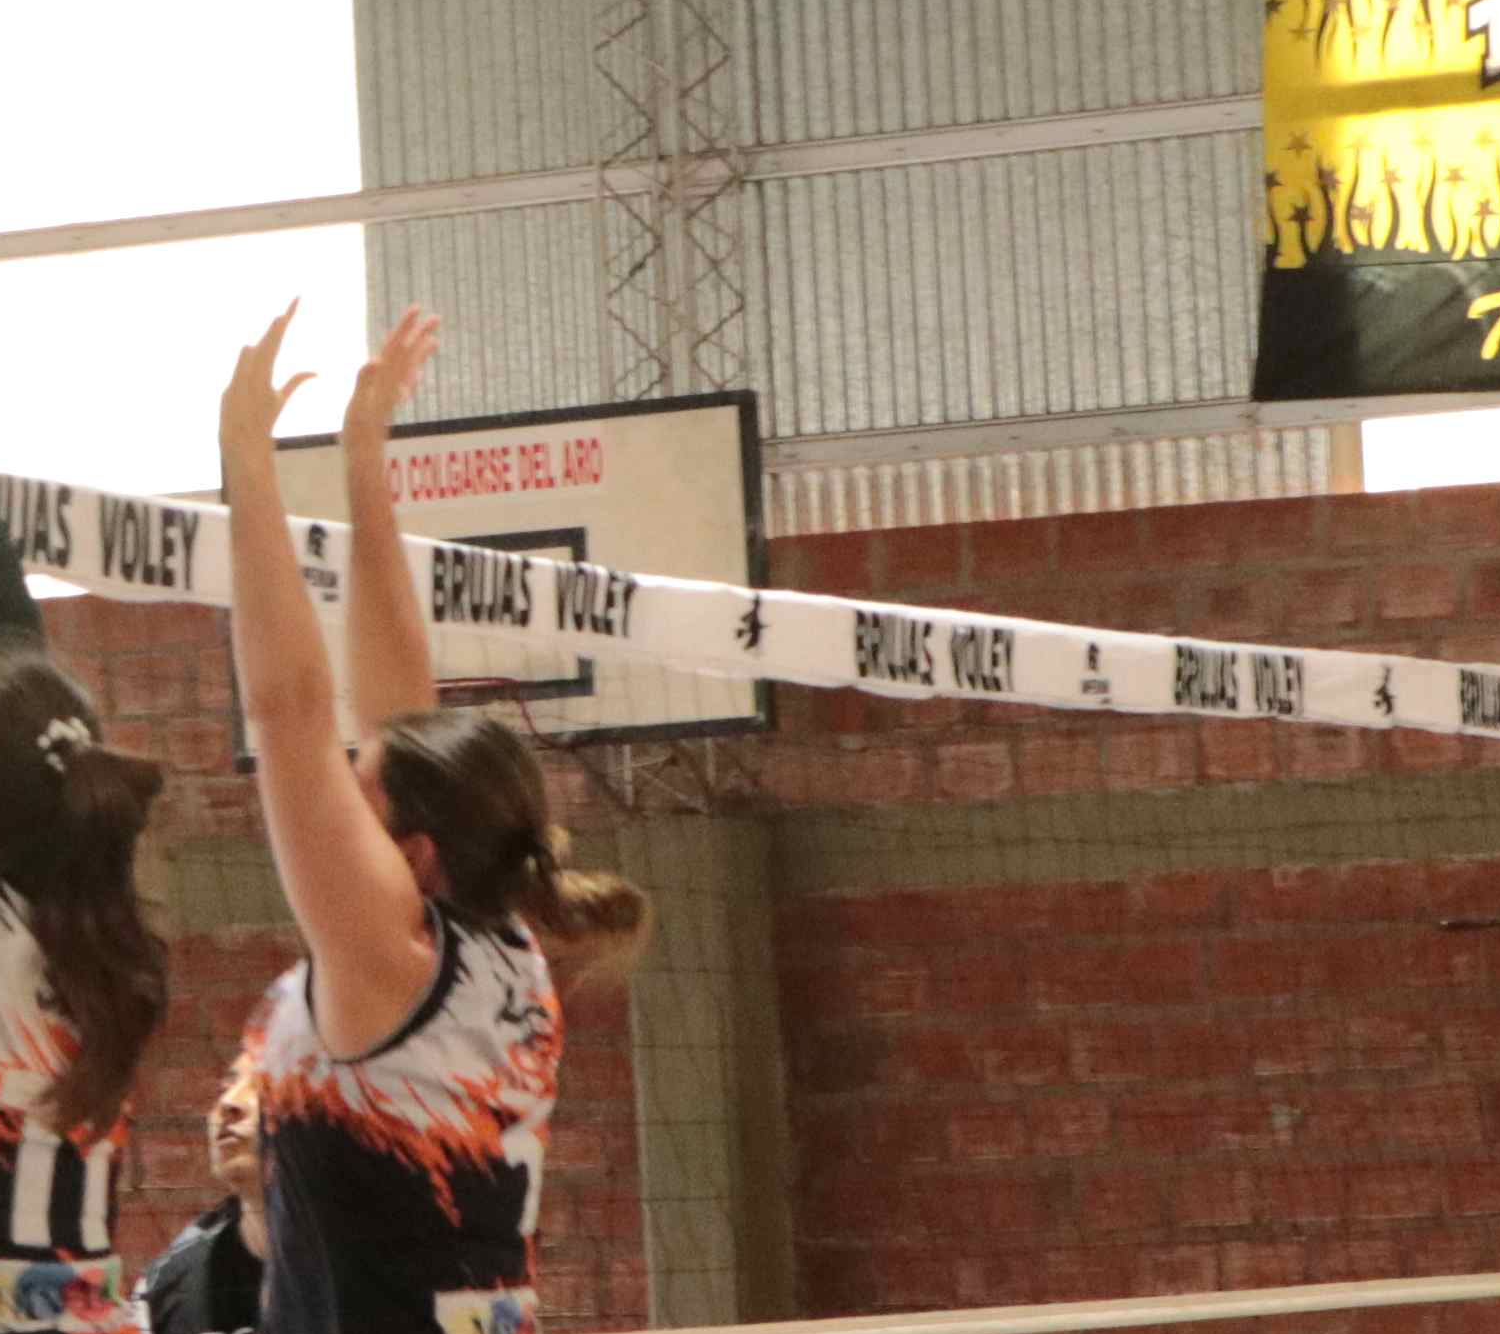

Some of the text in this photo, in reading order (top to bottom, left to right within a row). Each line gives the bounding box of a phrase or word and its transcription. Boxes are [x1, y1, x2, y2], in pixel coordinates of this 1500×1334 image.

[408, 445, 513, 502] COLGARSE
[519, 442, 556, 491] DEL
[563, 437, 604, 487] ARO
[100, 498, 199, 590] VOLEY
[432, 547, 639, 638] BRUJAS VOLEY
[855, 610, 1015, 692] BRUJAS VOLEY
[1173, 644, 1239, 710] BRUJAS
